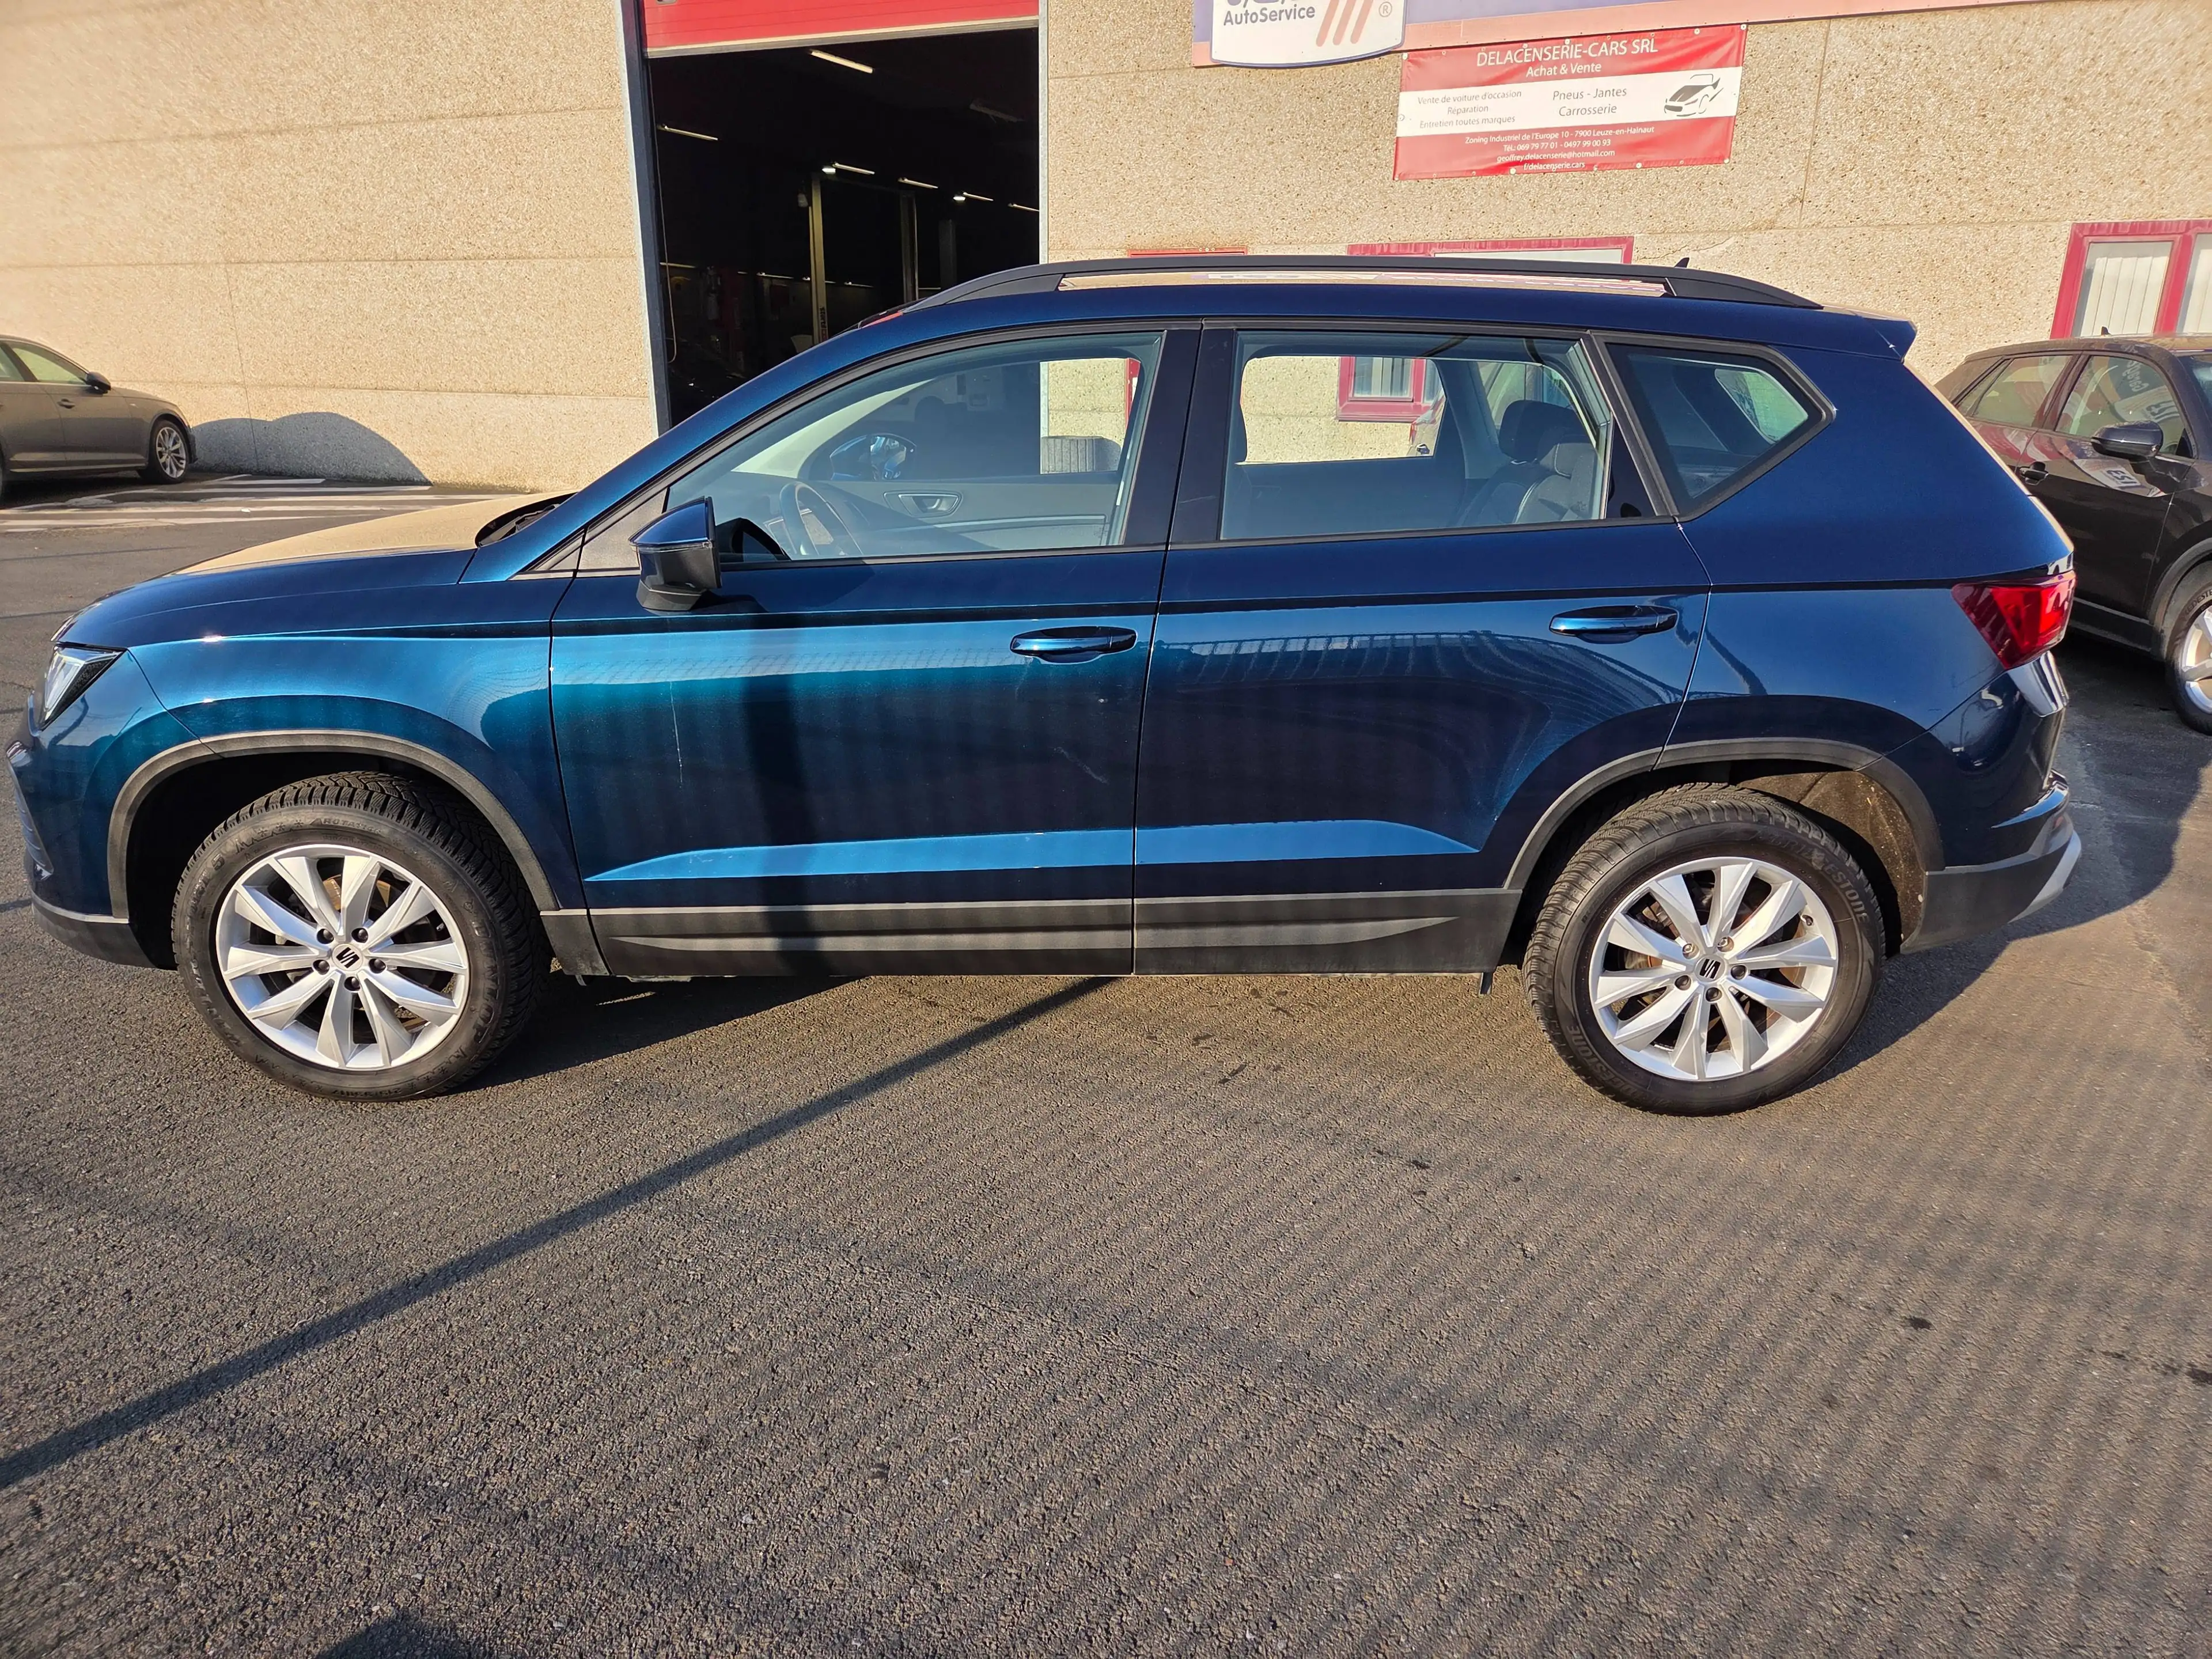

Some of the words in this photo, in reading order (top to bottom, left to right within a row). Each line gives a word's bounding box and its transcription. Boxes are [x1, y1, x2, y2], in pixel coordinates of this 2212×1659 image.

[1224, 3, 1315, 26] AutoService
[1476, 41, 1627, 67] DELACENSERIE-CARS
[1631, 39, 1658, 54] SRL
[1526, 64, 1558, 78] Achat
[1560, 64, 1568, 74] &
[1570, 62, 1602, 74] Vente
[1417, 97, 1439, 105] Vente
[1441, 95, 1450, 103] de
[1453, 94, 1479, 103] voiture
[1481, 90, 1522, 100] d'occasion
[1553, 90, 1584, 100] Pneus
[1593, 88, 1627, 99] Jantes
[1447, 104, 1488, 115] Réparation
[1559, 104, 1618, 116] Carrosserie
[1419, 120, 1453, 128] Entretien
[1455, 118, 1479, 126] toutes
[1482, 115, 1516, 125] marques
[1465, 137, 1488, 145] Zoning
[1490, 134, 1521, 142] Industriel
[1593, 126, 1654, 137] Leuze-en-Hainaut
